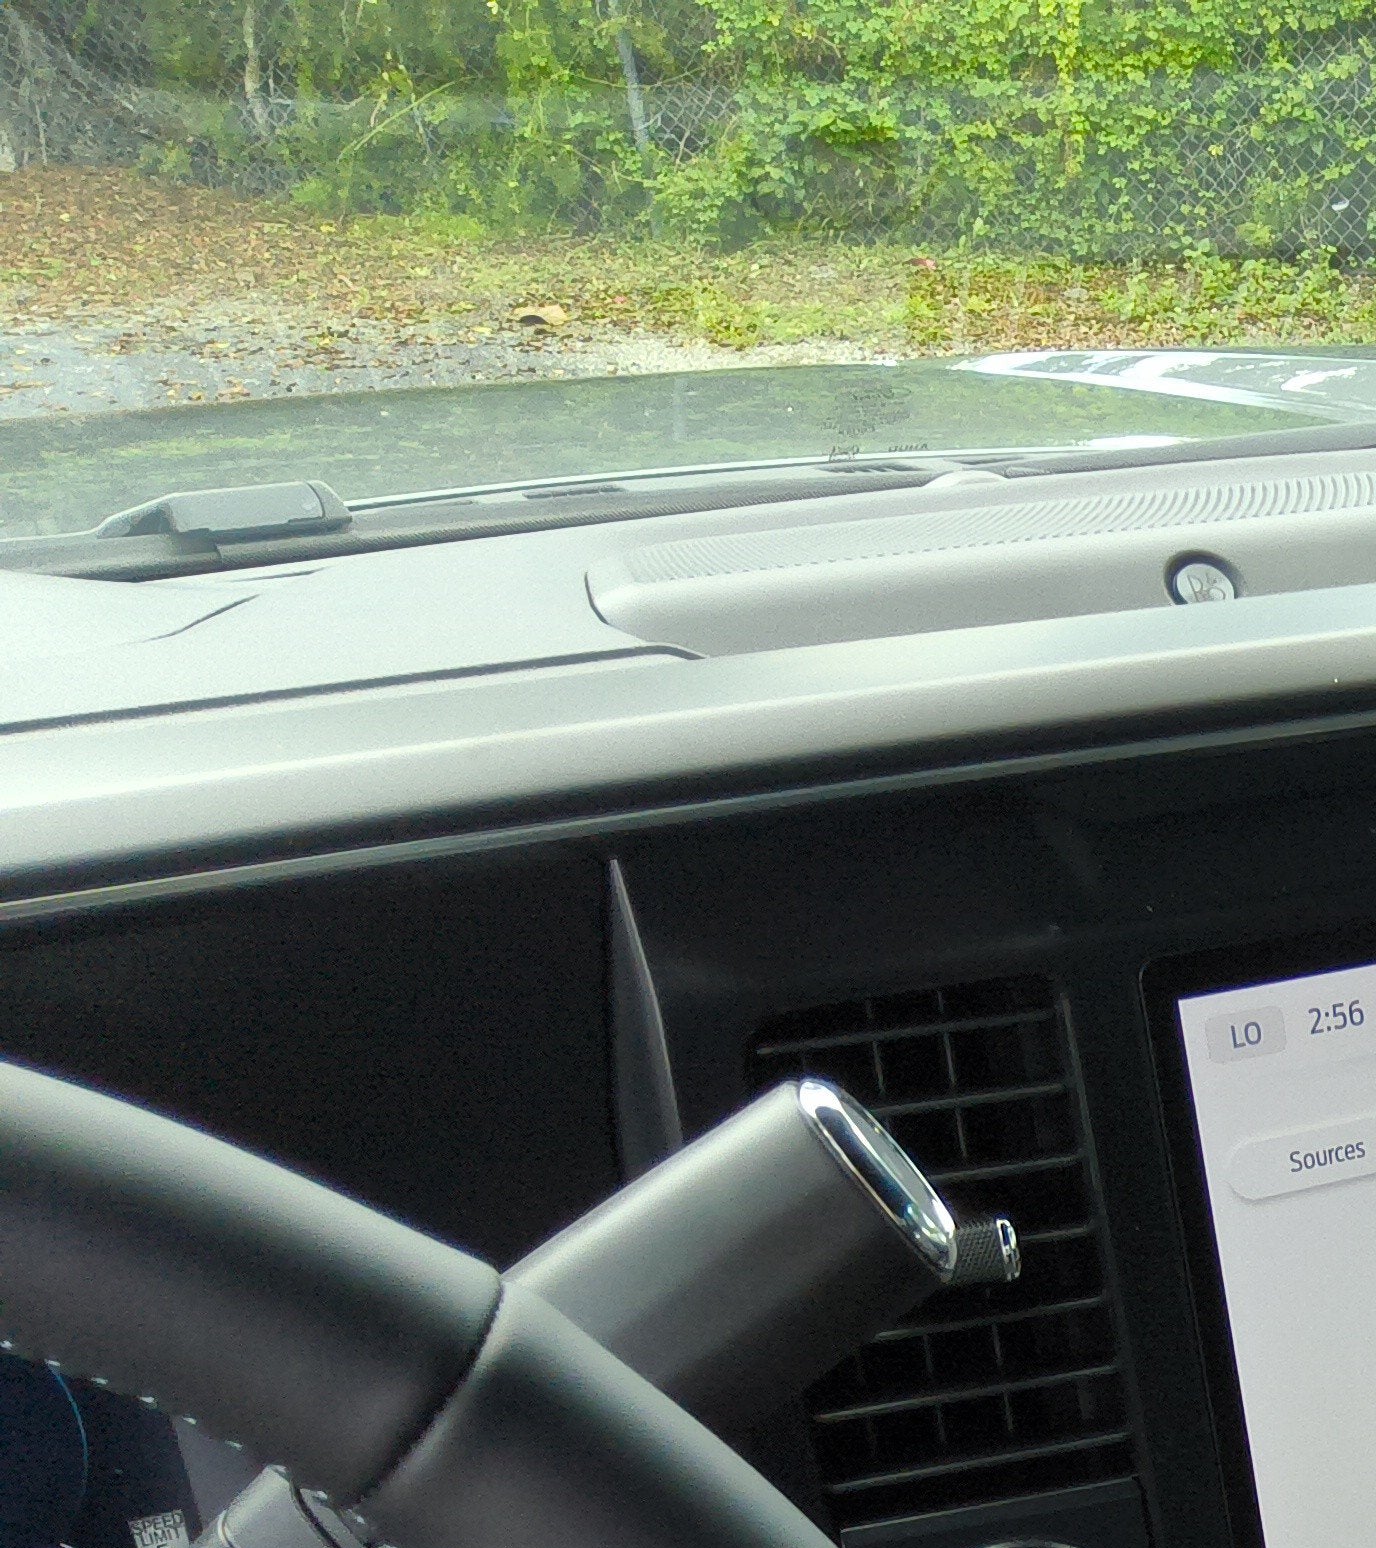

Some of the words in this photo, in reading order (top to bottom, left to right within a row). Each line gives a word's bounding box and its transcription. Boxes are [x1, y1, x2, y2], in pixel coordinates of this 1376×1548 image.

[1231, 1021, 1262, 1049] LO
[1308, 1000, 1365, 1034] 2:56
[1290, 1141, 1366, 1173] Sources
[130, 1512, 183, 1533] SPEED
